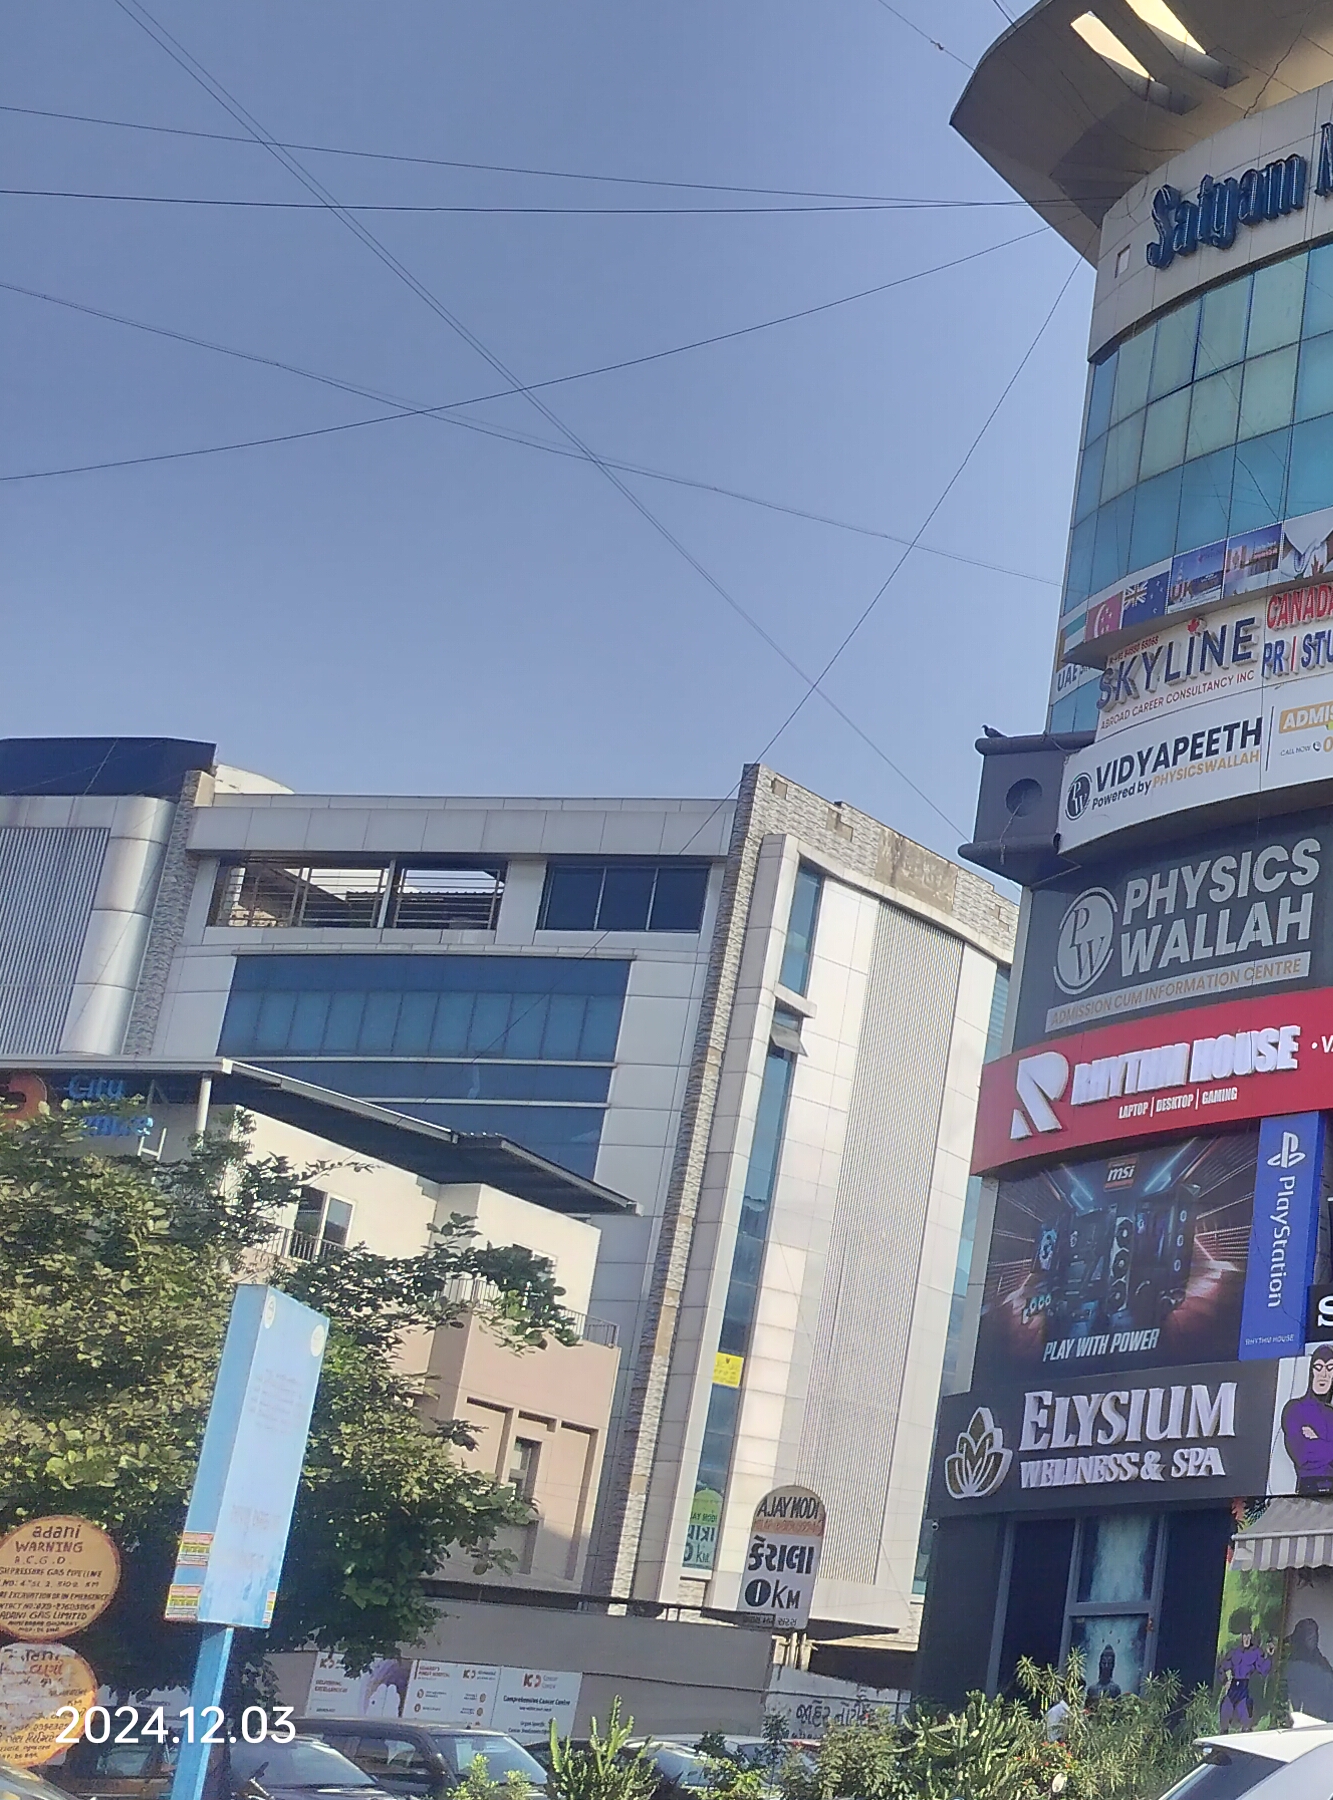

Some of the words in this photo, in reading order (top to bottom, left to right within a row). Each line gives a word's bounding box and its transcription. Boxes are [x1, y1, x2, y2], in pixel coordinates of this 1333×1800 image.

[1146, 152, 1306, 269] Satyam
[1097, 616, 1257, 712] SKYLINE
[1262, 639, 1286, 678] PR
[1101, 708, 1131, 730] ABROAD
[1132, 696, 1164, 718] CAREER
[1166, 675, 1234, 704] CONSULTANCY
[1236, 669, 1255, 685] INC
[1091, 781, 1136, 811] Powered
[1137, 779, 1154, 797] by
[1152, 749, 1260, 789] PHYSICSWALLAH
[1096, 716, 1264, 793] VIDYAPEETH
[1122, 837, 1322, 926] PHYSICS
[1120, 892, 1314, 978] WALLAH
[1051, 998, 1112, 1027] ADMISSION
[1113, 989, 1143, 1010] CUM
[1144, 971, 1240, 1001] INFORMATION
[1243, 957, 1302, 983] CENTRE
[1190, 1025, 1302, 1083] HOUSE
[1118, 1101, 1149, 1120] LAPTOP
[1155, 1094, 1195, 1114] DESKTOP
[1202, 1086, 1239, 1106] GAMING
[1266, 1175, 1297, 1309] PlayStation
[1043, 1339, 1075, 1363] PLAY
[1074, 1333, 1111, 1358] WITH
[1110, 1328, 1161, 1354] POWER
[1018, 1382, 1238, 1452] ELYSIUM
[1020, 1451, 1140, 1489] WELLNESS
[1140, 1450, 1166, 1482] &
[1171, 1447, 1227, 1478] SPA
[15, 1541, 84, 1553] WARNING
[33, 1524, 82, 1539] adani
